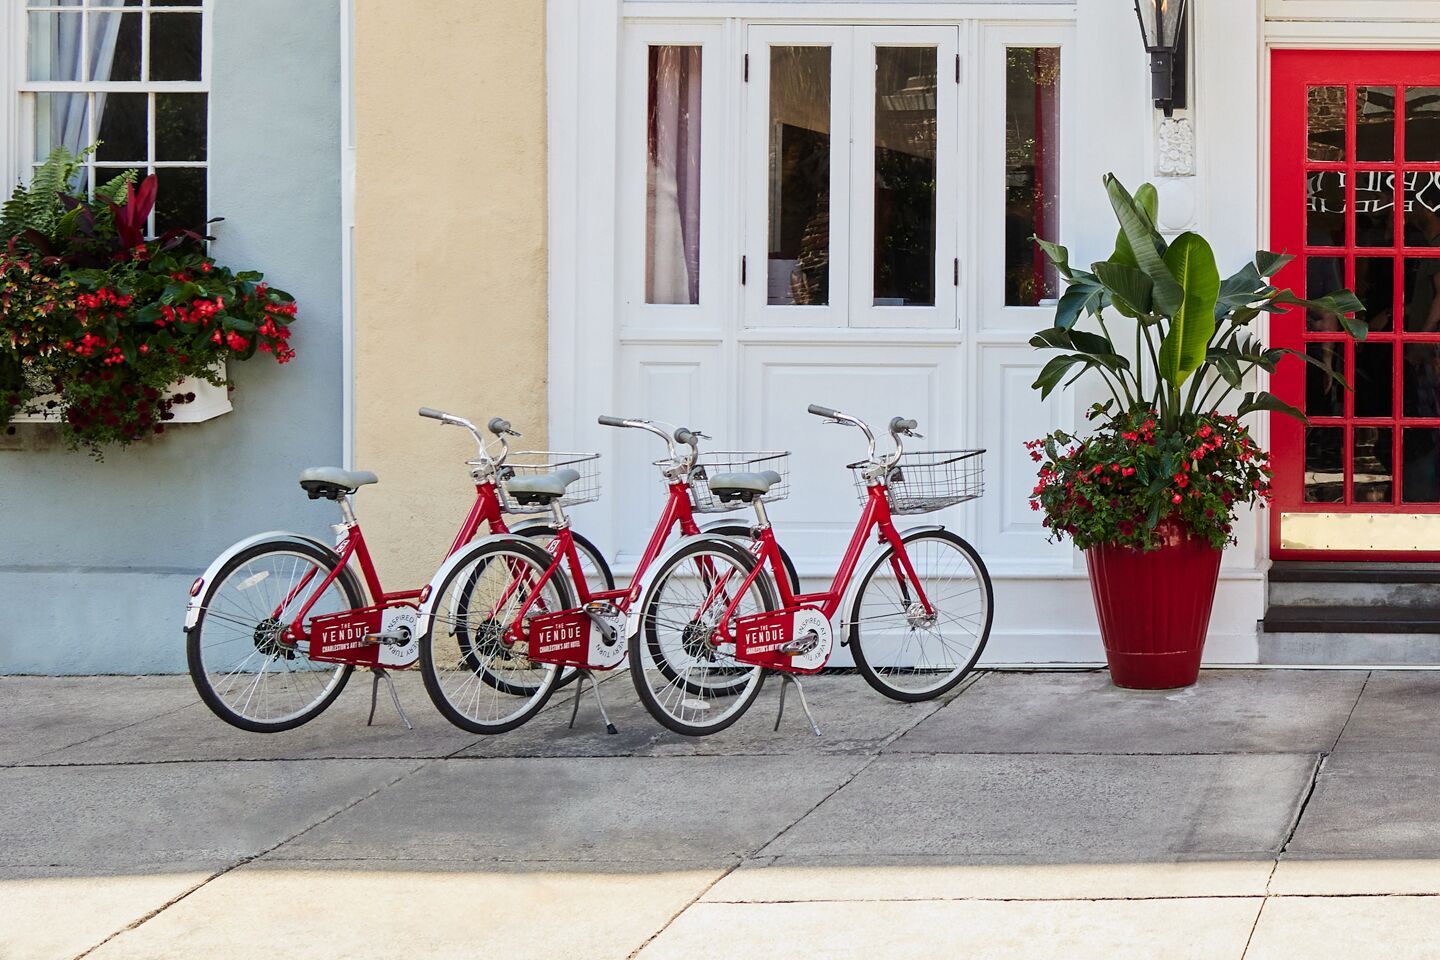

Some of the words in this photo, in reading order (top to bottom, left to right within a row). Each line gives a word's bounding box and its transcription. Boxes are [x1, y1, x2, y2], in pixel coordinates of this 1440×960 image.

[539, 626, 581, 643] VENDUE
[798, 617, 821, 635] INSPIRED
[745, 628, 784, 645] VENDUE
